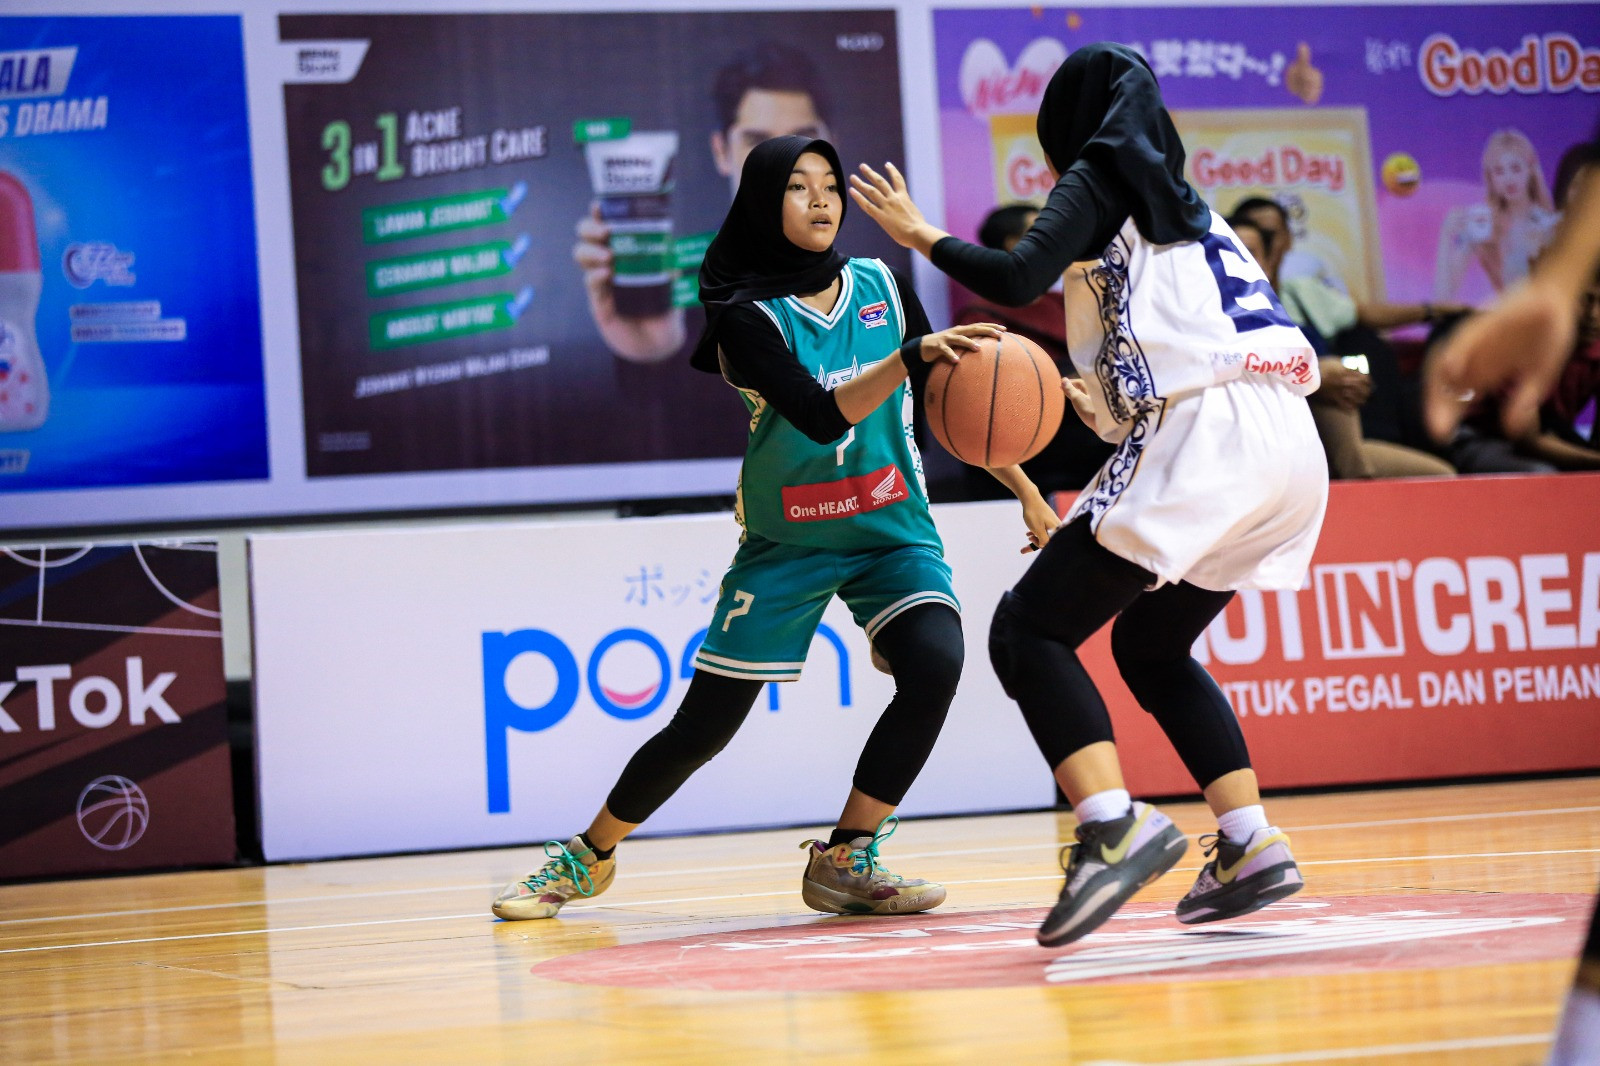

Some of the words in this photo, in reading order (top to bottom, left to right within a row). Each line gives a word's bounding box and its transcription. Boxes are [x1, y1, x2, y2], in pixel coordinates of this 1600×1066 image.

[1420, 36, 1541, 94] Good
[15, 95, 108, 136] DRAMA
[321, 121, 352, 190] 3
[353, 143, 378, 175] IN
[375, 112, 405, 182] 1
[1192, 147, 1276, 186] Good
[1281, 148, 1346, 191] Day
[790, 505, 816, 518] One
[872, 490, 904, 506] HONDA
[722, 590, 755, 632] 7
[1190, 568, 1312, 666] OT
[1303, 673, 1413, 714] PEGAL
[1417, 668, 1486, 708] DAN
